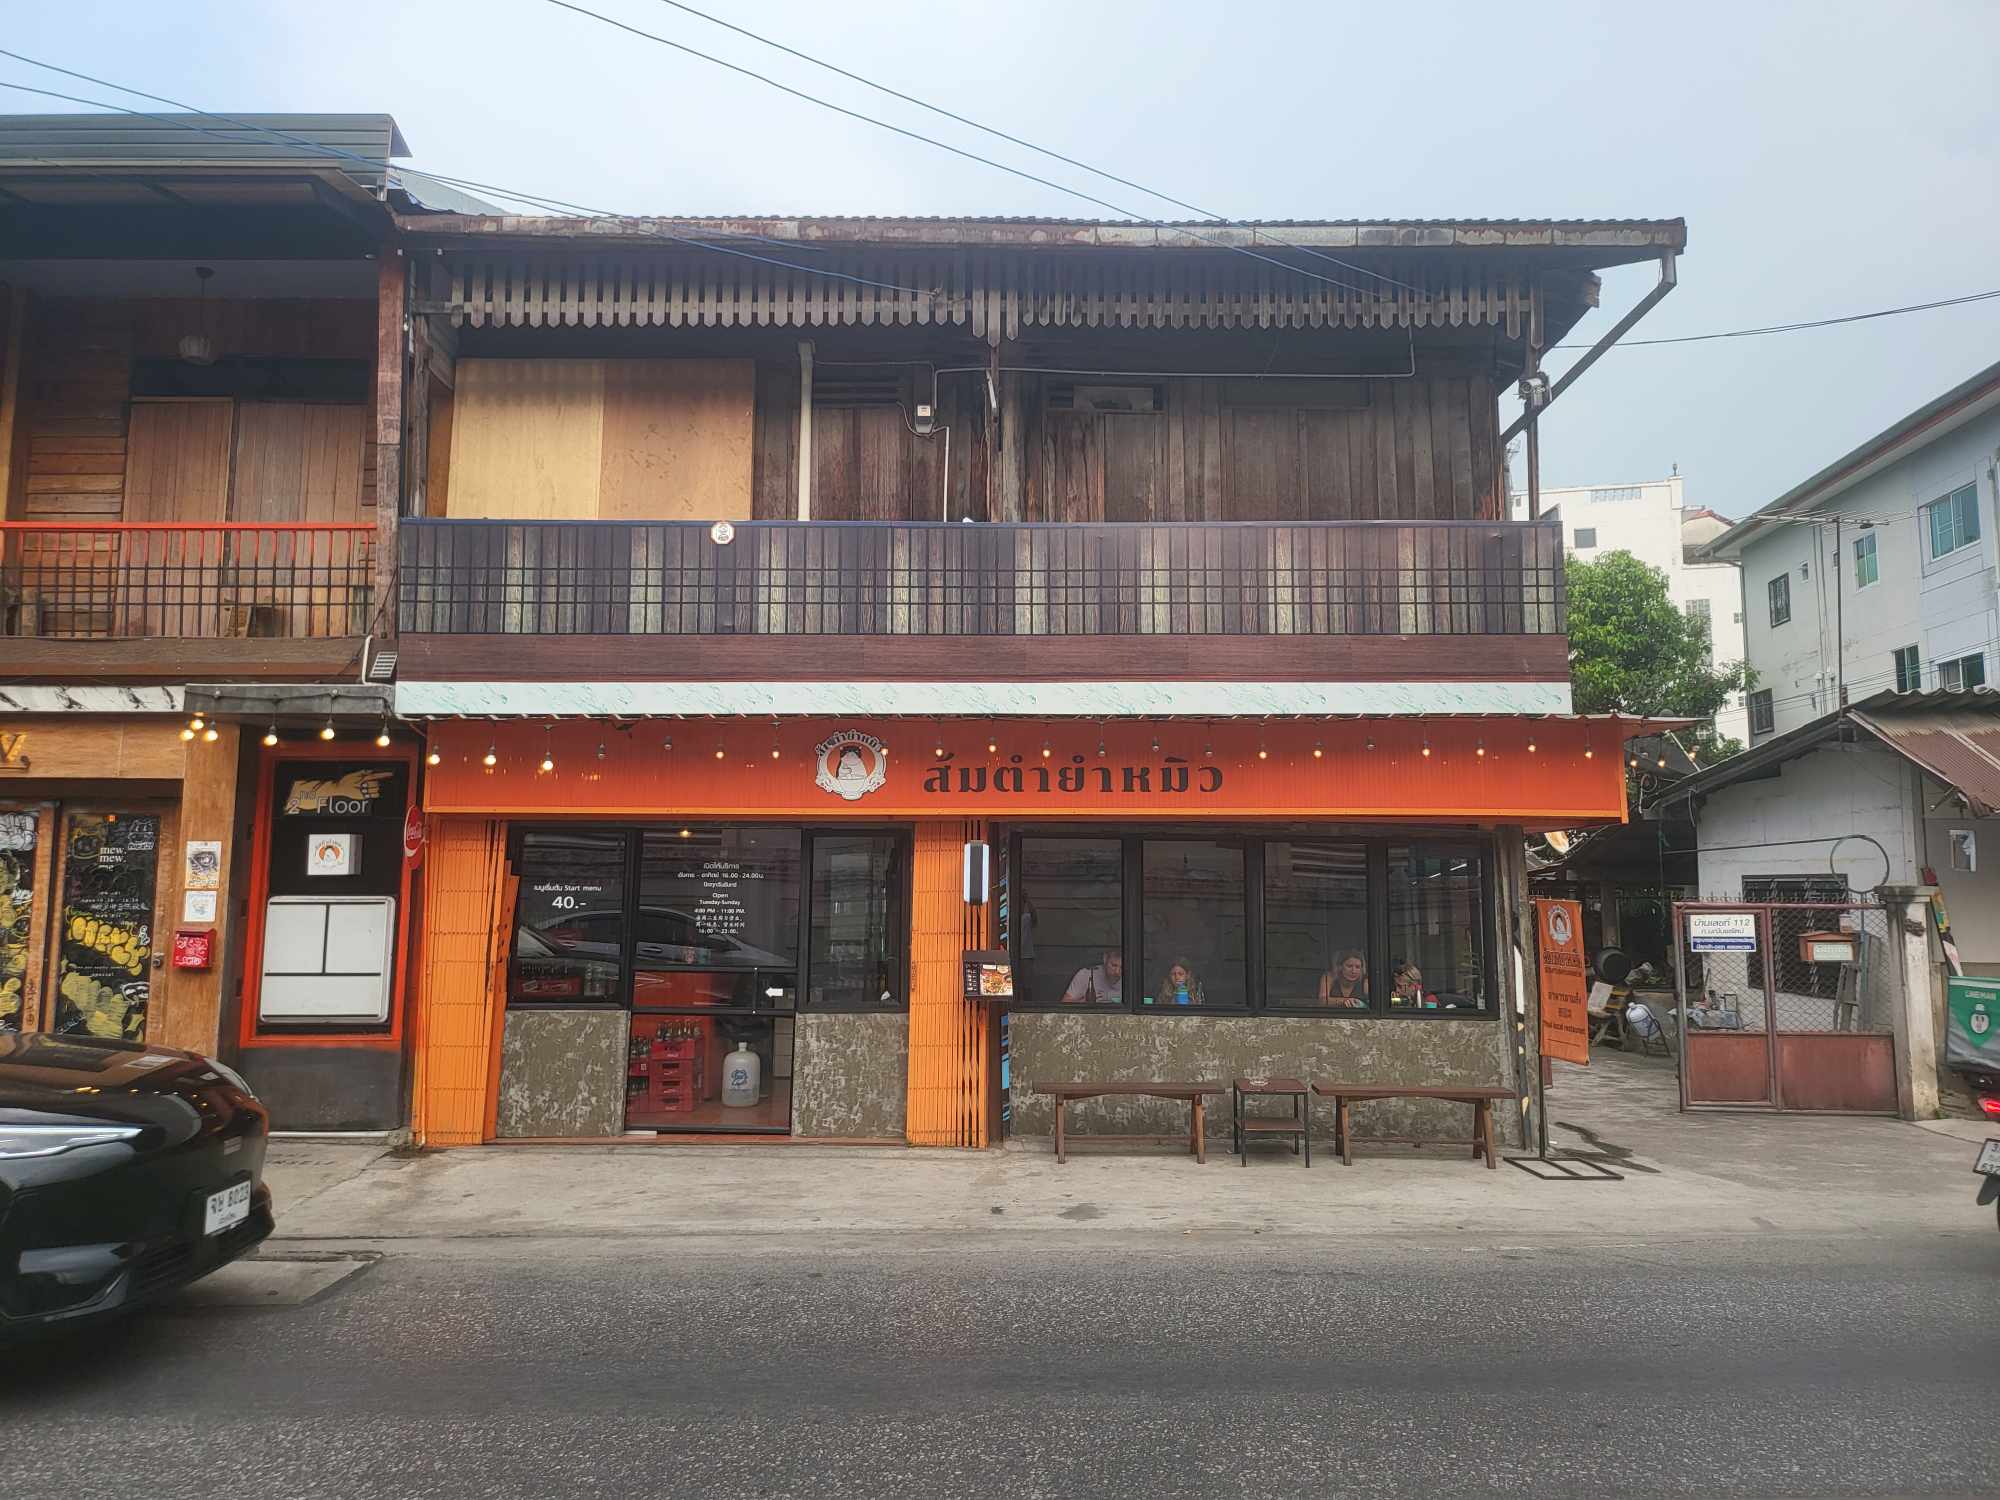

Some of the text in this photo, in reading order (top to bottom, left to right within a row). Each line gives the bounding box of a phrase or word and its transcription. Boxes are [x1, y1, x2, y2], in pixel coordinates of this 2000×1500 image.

[317, 795, 369, 814] Floor
[551, 896, 587, 909] 40.-
[1734, 918, 1751, 927] 112
